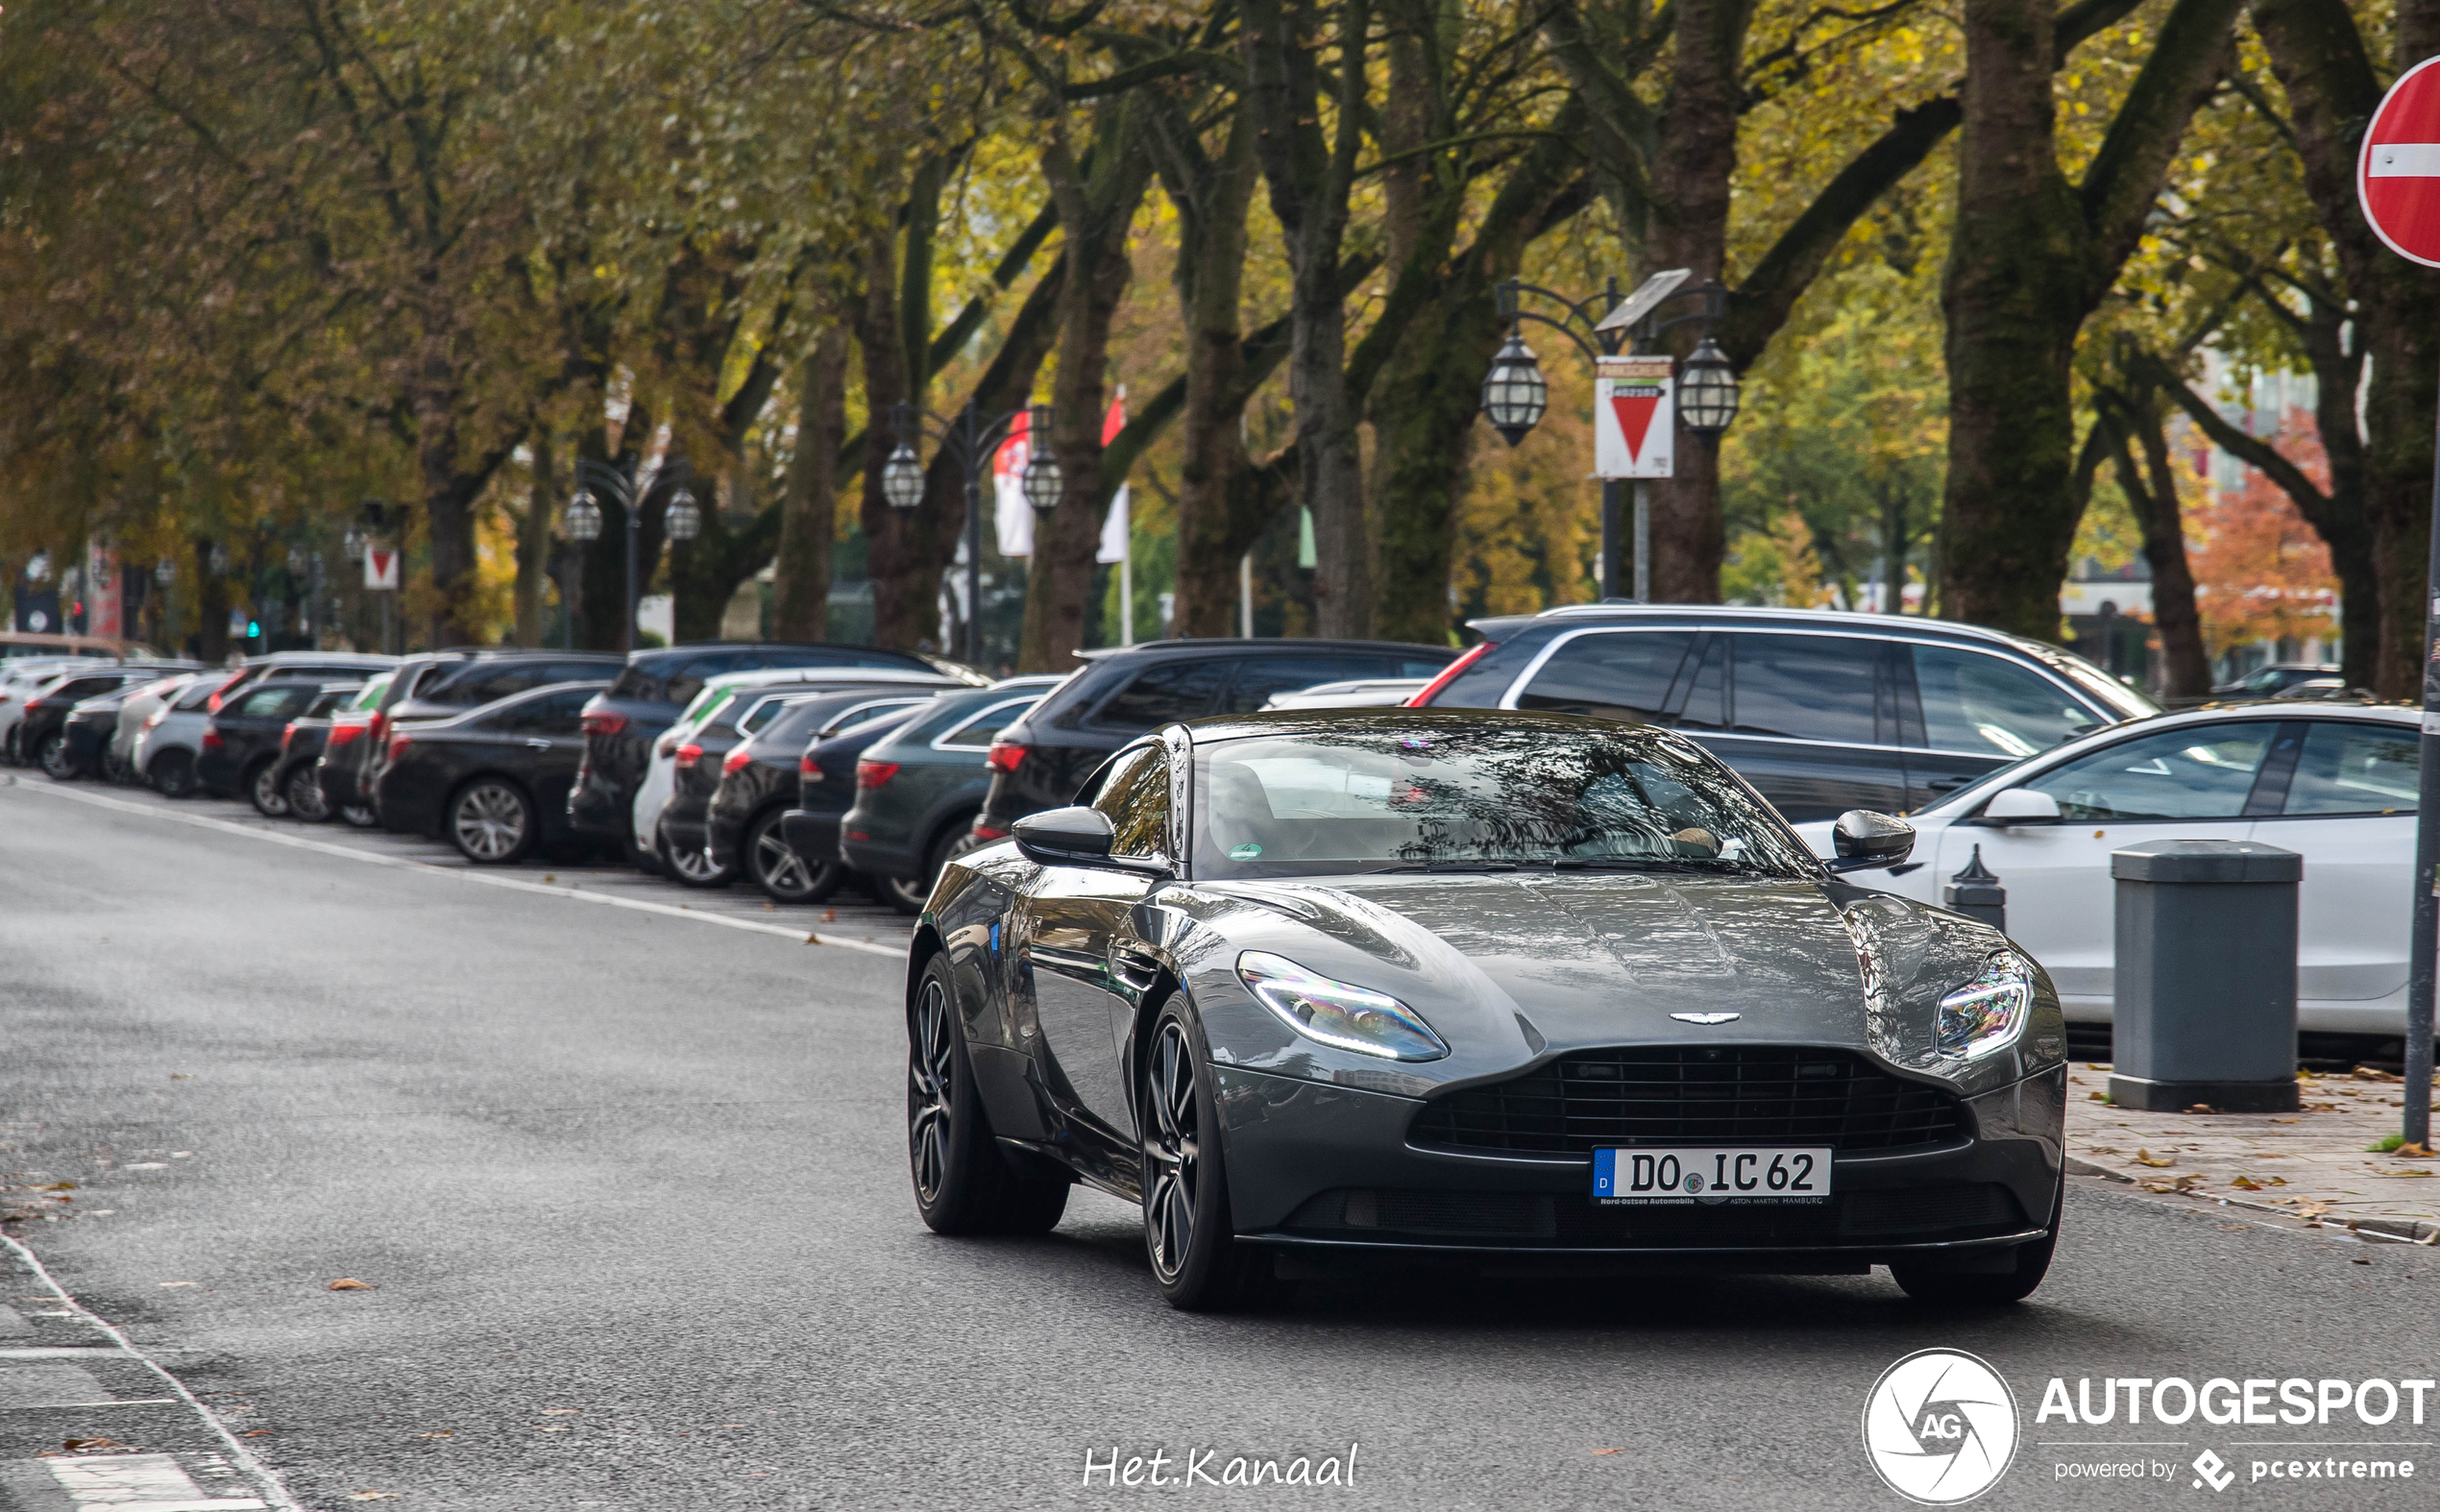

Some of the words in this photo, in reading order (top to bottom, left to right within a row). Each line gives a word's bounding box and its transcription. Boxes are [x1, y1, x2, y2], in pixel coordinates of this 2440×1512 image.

[1241, 843, 1251, 852] 4
[1630, 1153, 1681, 1192] DO
[1710, 1153, 1758, 1191] IC
[1766, 1153, 1814, 1191] 62
[1598, 1178, 1608, 1188] D
